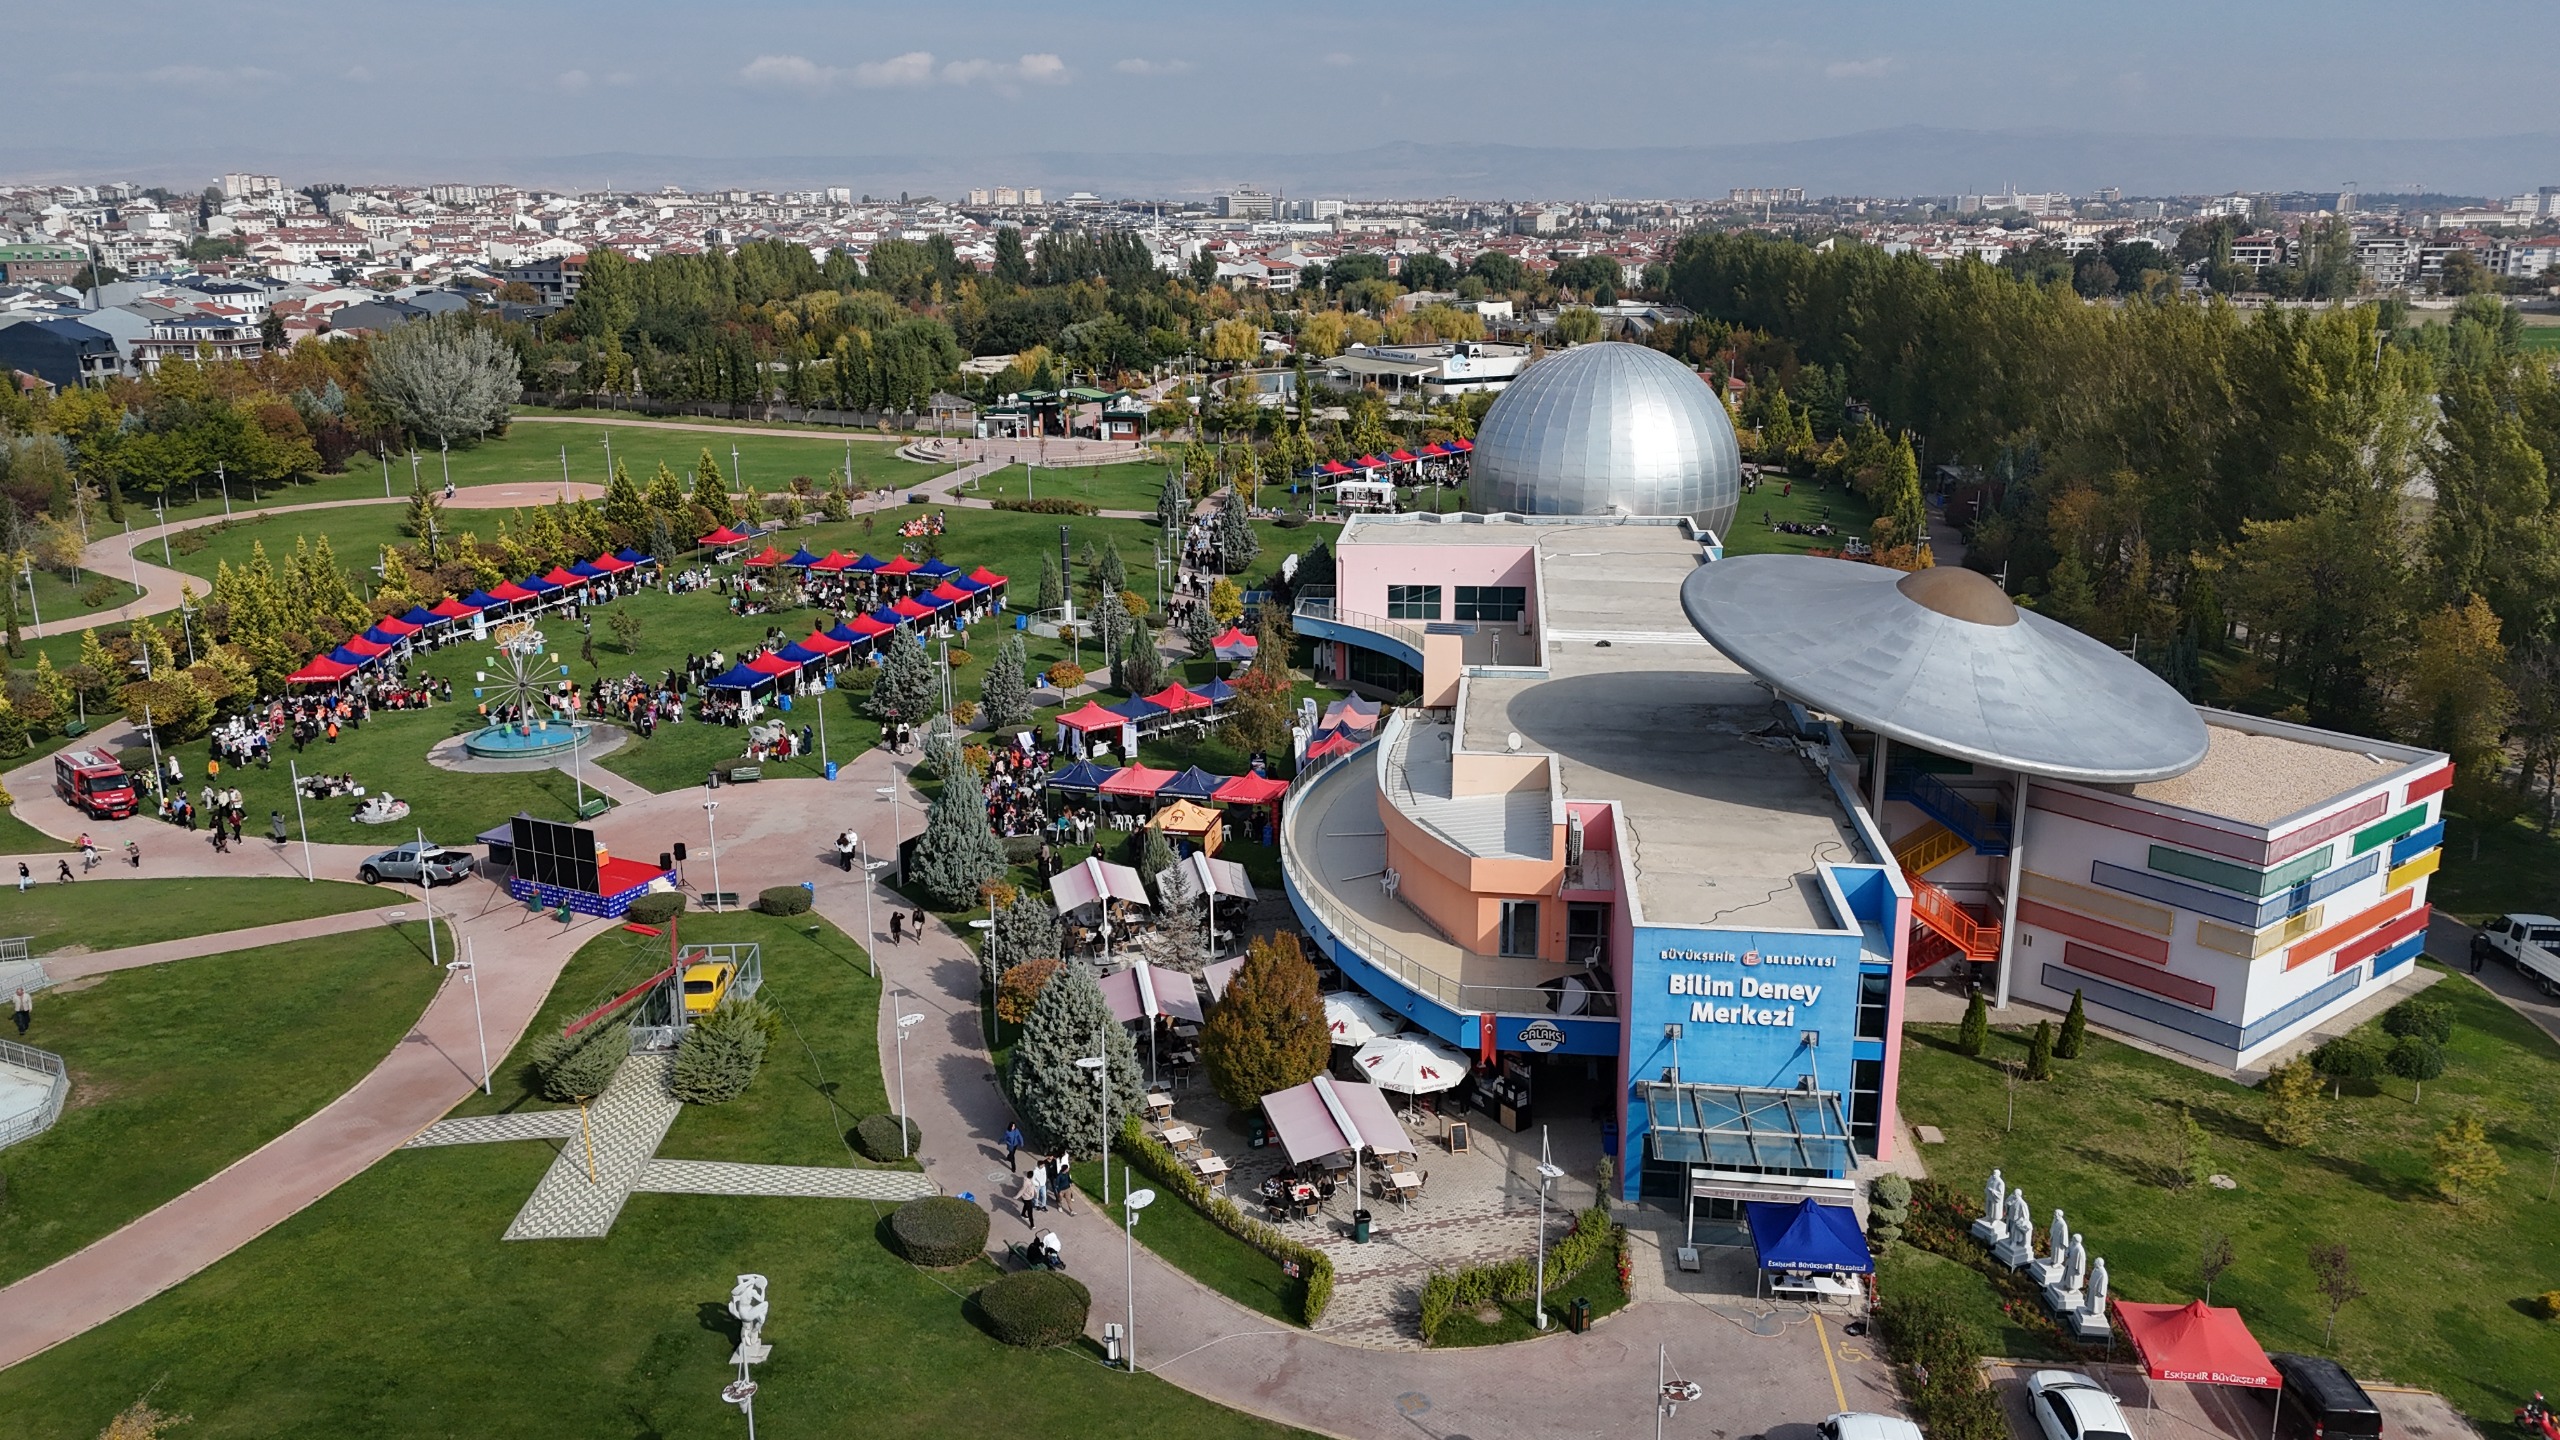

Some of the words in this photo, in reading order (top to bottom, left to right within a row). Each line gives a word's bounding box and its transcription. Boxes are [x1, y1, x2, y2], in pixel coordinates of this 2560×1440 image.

[1660, 948, 1736, 964] BÜYÜKŞEHİR
[1765, 954, 1837, 967] BELEDİYESİ
[1669, 974, 1734, 998] Bilim
[1741, 976, 1822, 1007] Deney
[1691, 1001, 1795, 1026] Merkezi
